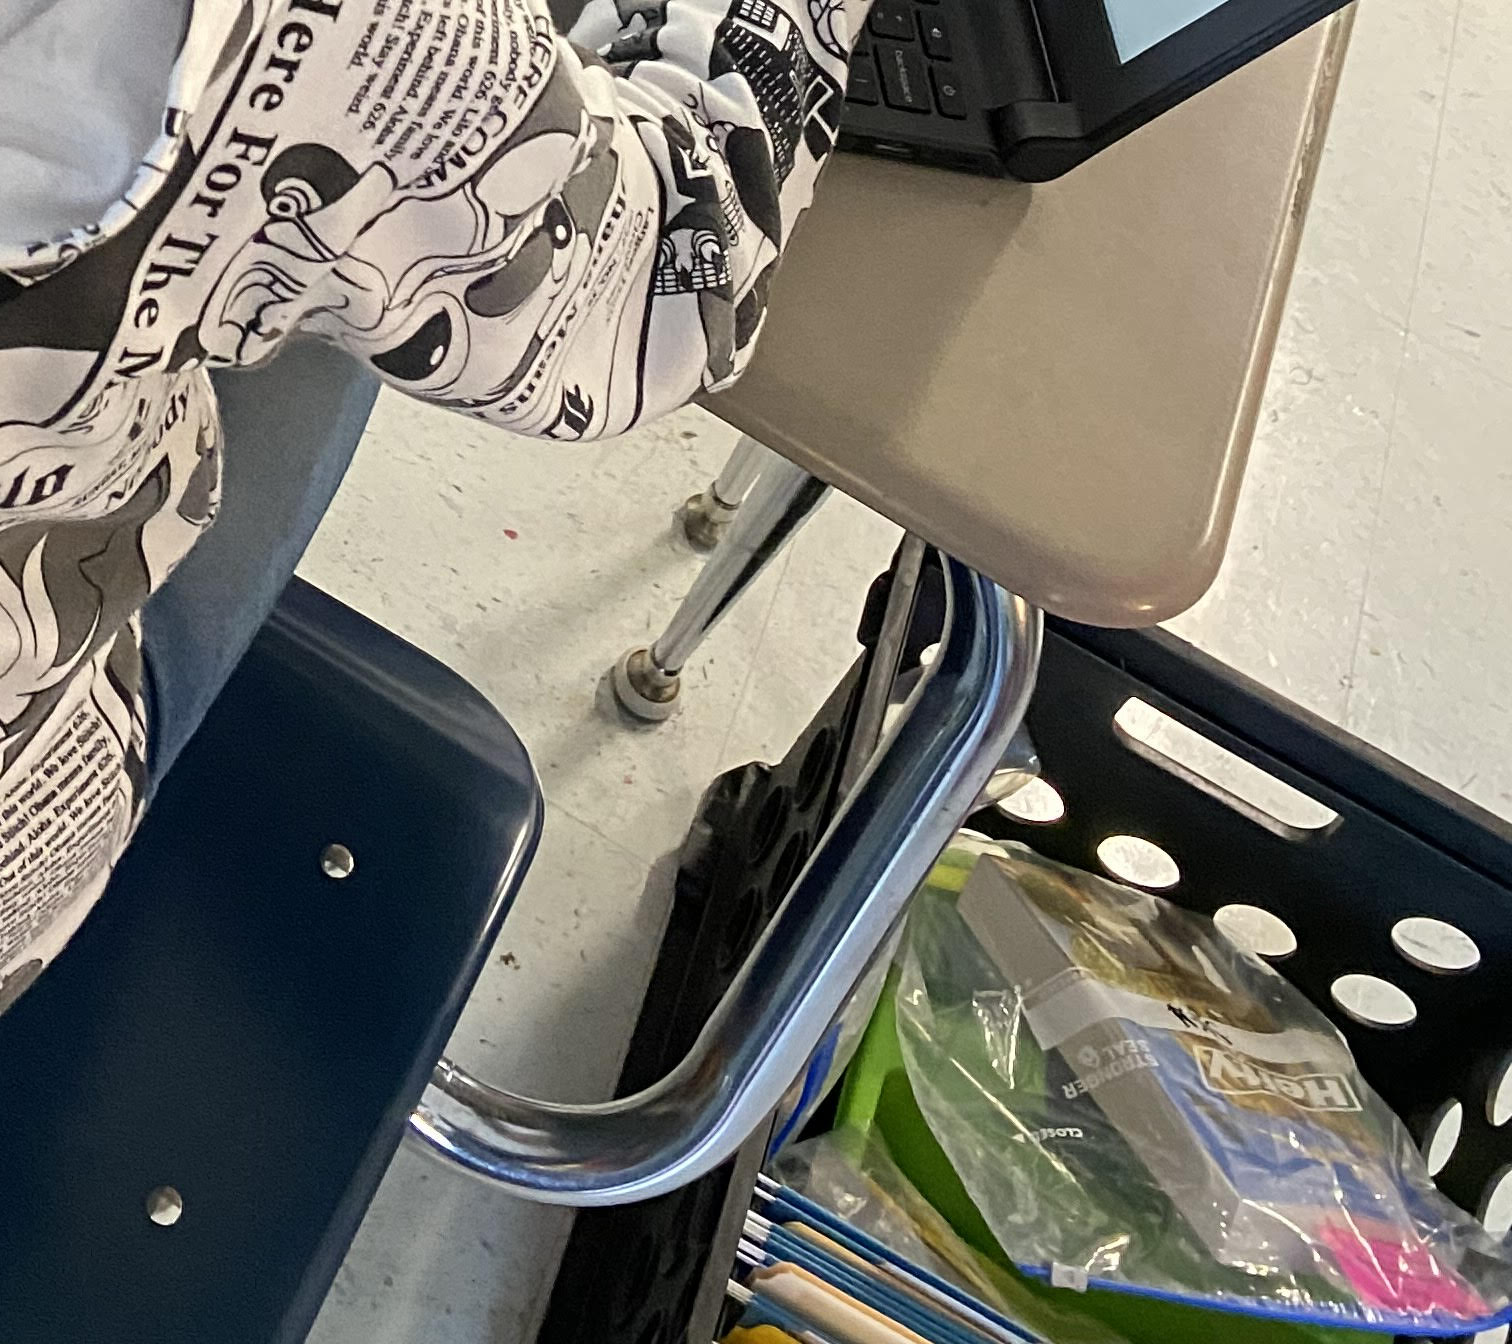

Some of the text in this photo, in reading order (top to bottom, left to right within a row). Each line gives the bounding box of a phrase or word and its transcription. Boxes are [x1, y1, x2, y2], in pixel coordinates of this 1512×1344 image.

[346, 17, 383, 75] world.
[370, 30, 402, 71] Stay
[360, 97, 392, 137] 626.
[187, 126, 279, 220] For
[133, 227, 220, 328] The
